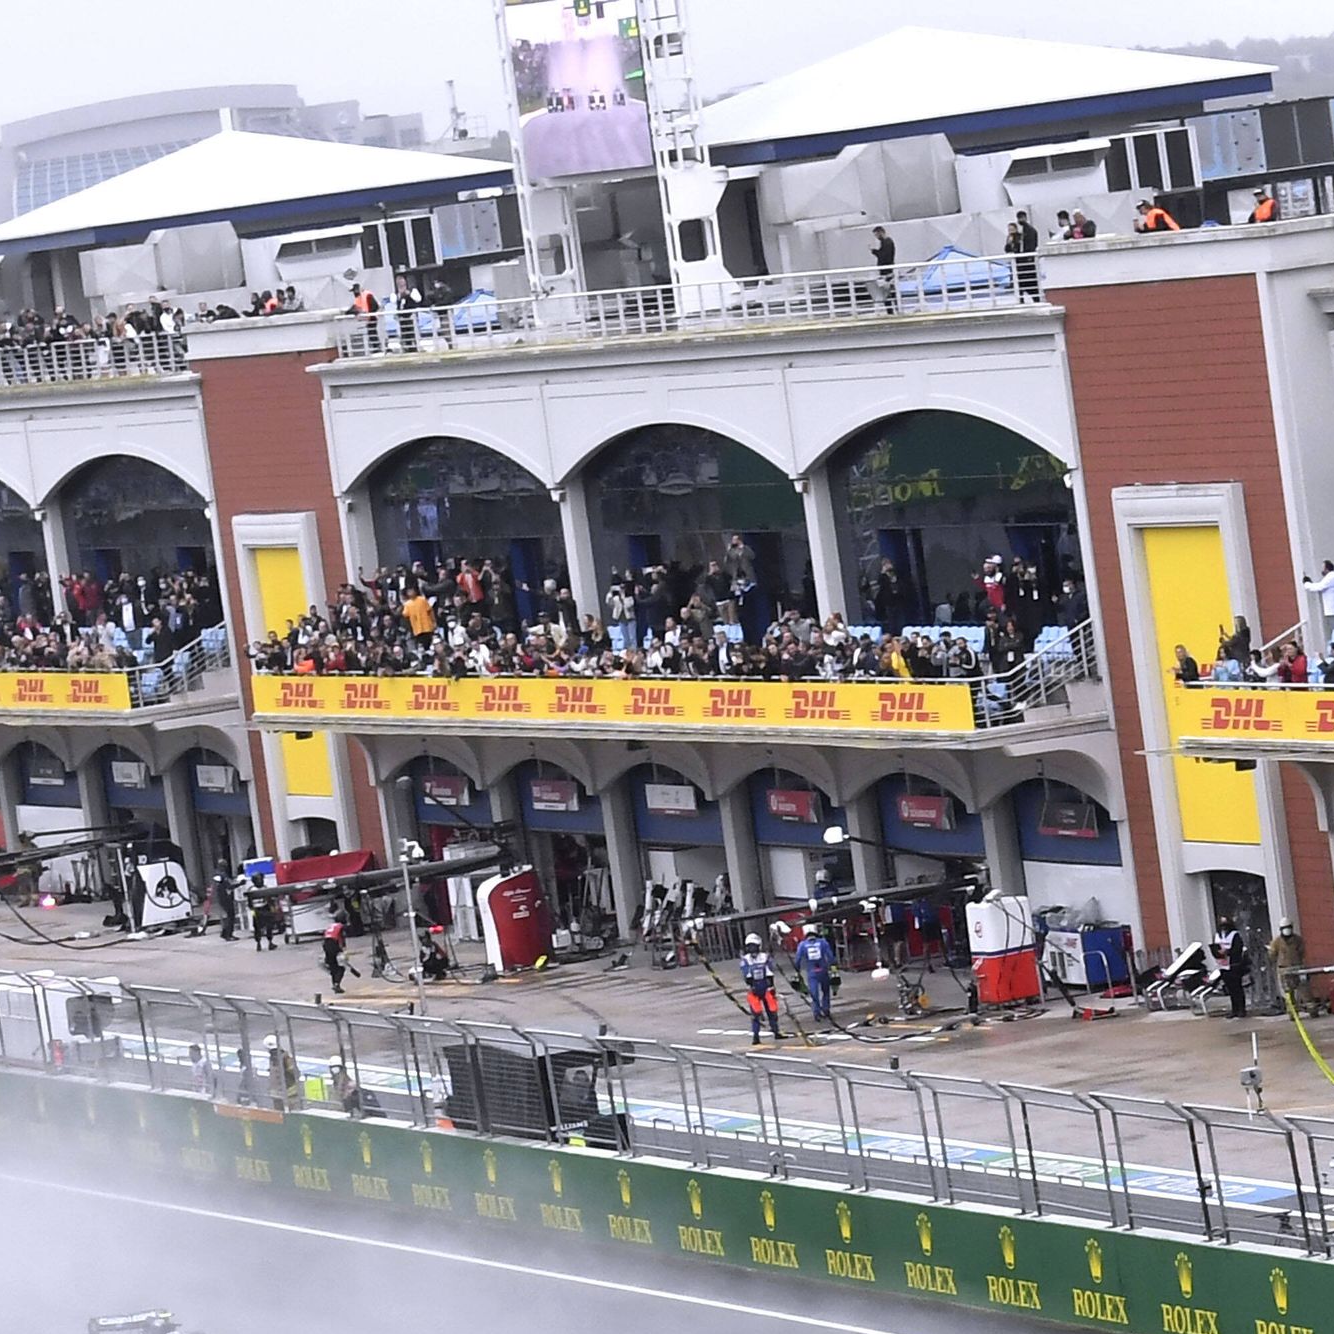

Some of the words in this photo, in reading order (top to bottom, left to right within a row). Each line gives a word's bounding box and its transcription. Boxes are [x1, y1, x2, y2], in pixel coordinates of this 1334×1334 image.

[280, 683, 318, 708] DHL
[344, 683, 383, 709] DHL
[412, 684, 451, 711] DHL
[481, 685, 523, 712] DHL
[555, 686, 598, 714] DHL
[631, 687, 675, 716] DHL
[709, 689, 757, 717] DHL
[792, 690, 841, 719] DHL
[878, 692, 930, 722] DHL
[1210, 698, 1271, 731] DHL
[475, 1193, 517, 1220] ROLEX
[540, 1203, 583, 1232] ROLEX
[607, 1213, 652, 1244] ROLEX
[678, 1225, 724, 1256] ROLEX
[750, 1237, 798, 1268] ROLEX
[826, 1249, 875, 1281] ROLEX
[905, 1262, 957, 1295] ROLEX
[986, 1275, 1041, 1310] ROLEX
[1072, 1288, 1129, 1325] ROLEX
